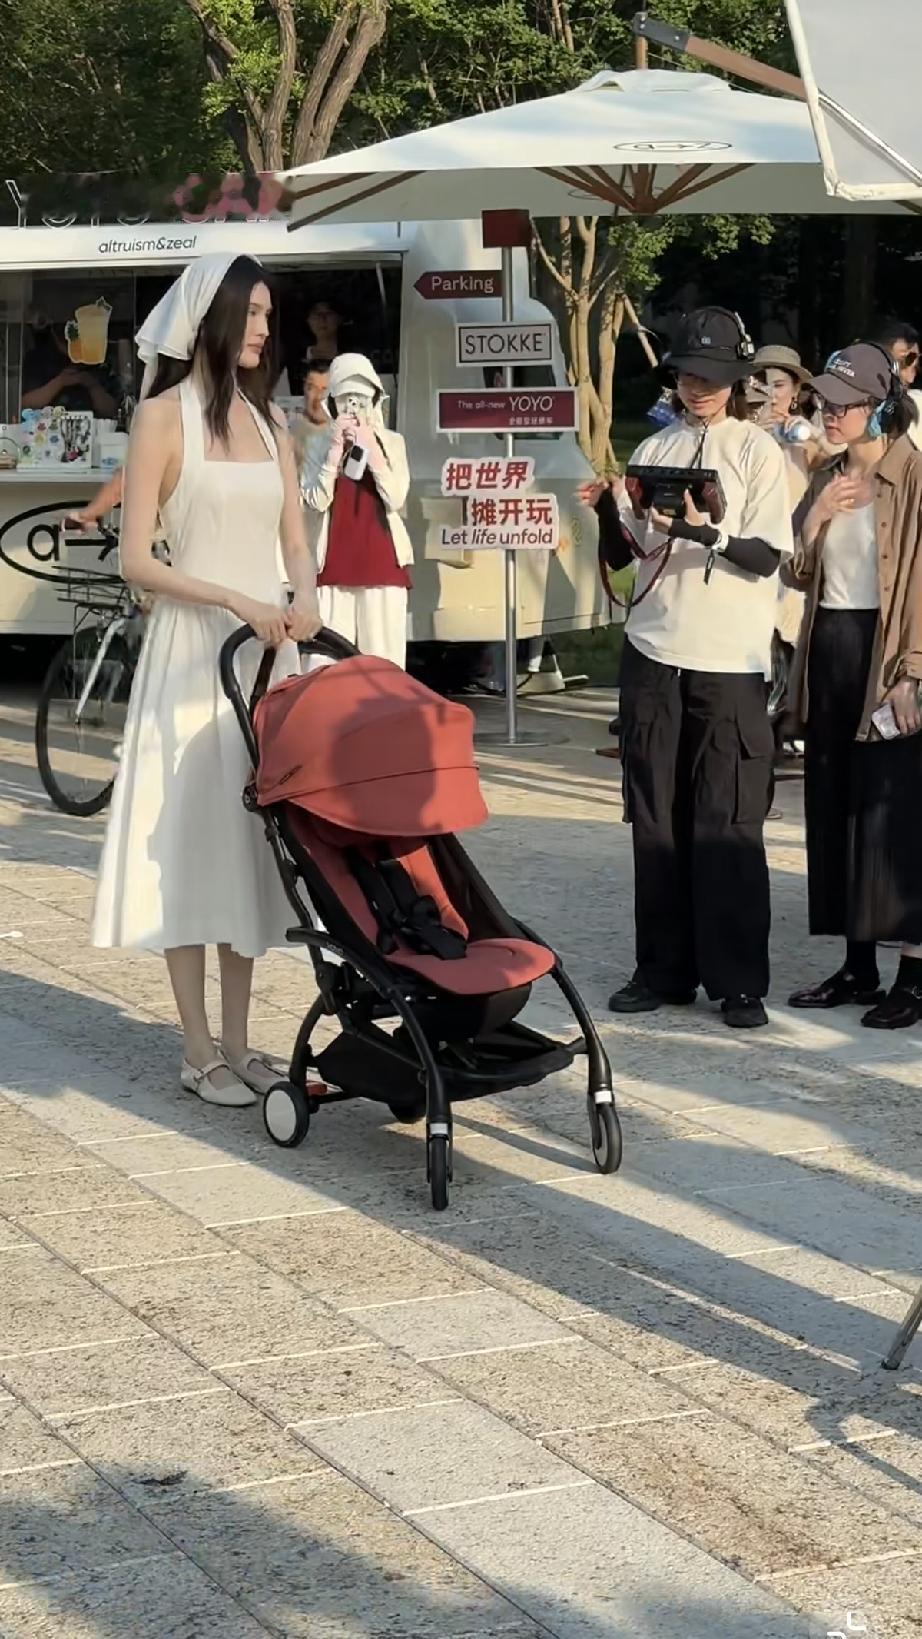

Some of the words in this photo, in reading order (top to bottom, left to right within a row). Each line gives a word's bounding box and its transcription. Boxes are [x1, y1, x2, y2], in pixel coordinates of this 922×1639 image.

[98, 235, 198, 254] altruism&zeal
[431, 275, 495, 294] Parking
[465, 332, 544, 355] STOKKE
[457, 400, 474, 409] The
[509, 396, 553, 412] YOYO
[446, 461, 527, 490] 把世界
[471, 498, 553, 527] 摊开玩
[442, 528, 468, 545] Let
[471, 528, 497, 545] life
[500, 528, 553, 545] unfold
